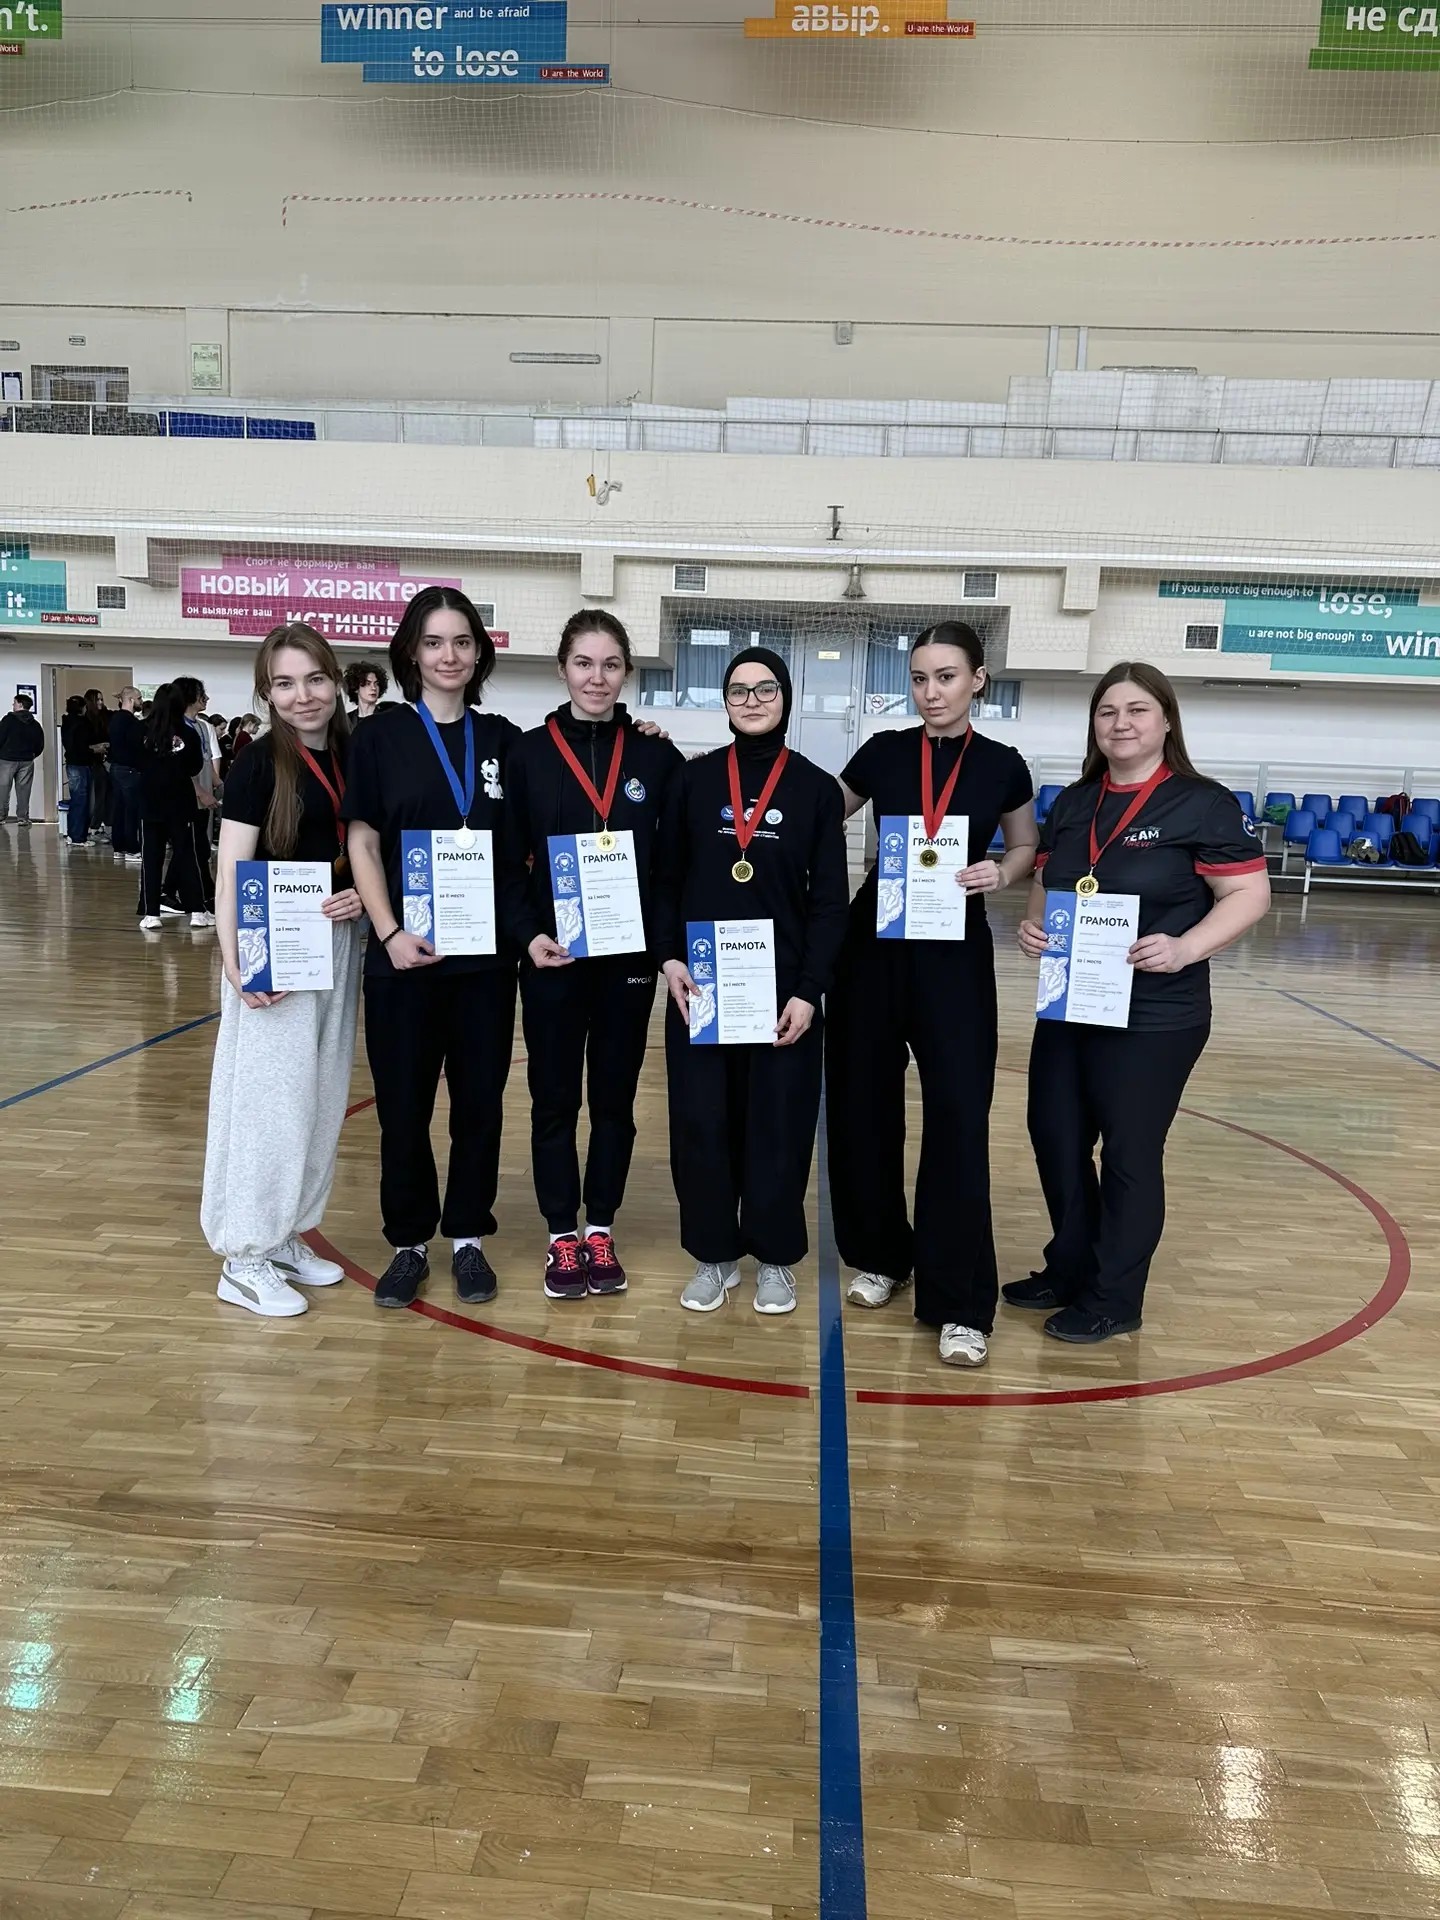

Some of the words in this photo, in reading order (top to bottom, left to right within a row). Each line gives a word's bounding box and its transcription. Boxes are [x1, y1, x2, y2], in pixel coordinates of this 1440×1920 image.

[337, 4, 448, 30] winner
[454, 7, 473, 18] and
[480, 7, 493, 18] be
[498, 6, 530, 18] afraid
[1346, 6, 1386, 32] не
[1398, 7, 1440, 37] сд
[932, 25, 944, 33] the
[947, 25, 969, 33] World
[412, 45, 444, 77] to
[456, 45, 519, 77] lose
[541, 69, 548, 77] U
[567, 69, 579, 77] the
[583, 69, 603, 78] World
[245, 557, 273, 568] Спорт
[294, 557, 349, 571] формирует
[356, 561, 375, 570] вам
[7, 590, 33, 617] it.
[1171, 582, 1180, 592] If
[1181, 584, 1200, 594] you
[1203, 585, 1219, 593] are
[1222, 585, 1239, 594] not
[1243, 583, 1259, 597] big
[1261, 586, 1300, 598] enough
[1303, 587, 1314, 596] to
[1318, 587, 1393, 619] lose,
[202, 606, 249, 616] выявляет
[253, 608, 272, 616] ваш
[1248, 629, 1256, 638] u
[1257, 630, 1273, 638] are
[1276, 630, 1294, 639] not
[1297, 628, 1313, 641] big
[1315, 630, 1355, 643] enough
[1362, 632, 1373, 641] to
[912, 838, 960, 846] ГРАМОТА
[1122, 830, 1160, 845] TEAM
[437, 852, 484, 861] ГРАМОТА
[582, 852, 628, 864] ГРАМОТА
[273, 884, 324, 894] ГРАМОТА
[1080, 916, 1130, 928] ГРАМОТА
[720, 942, 766, 950] ГРАМОТА
